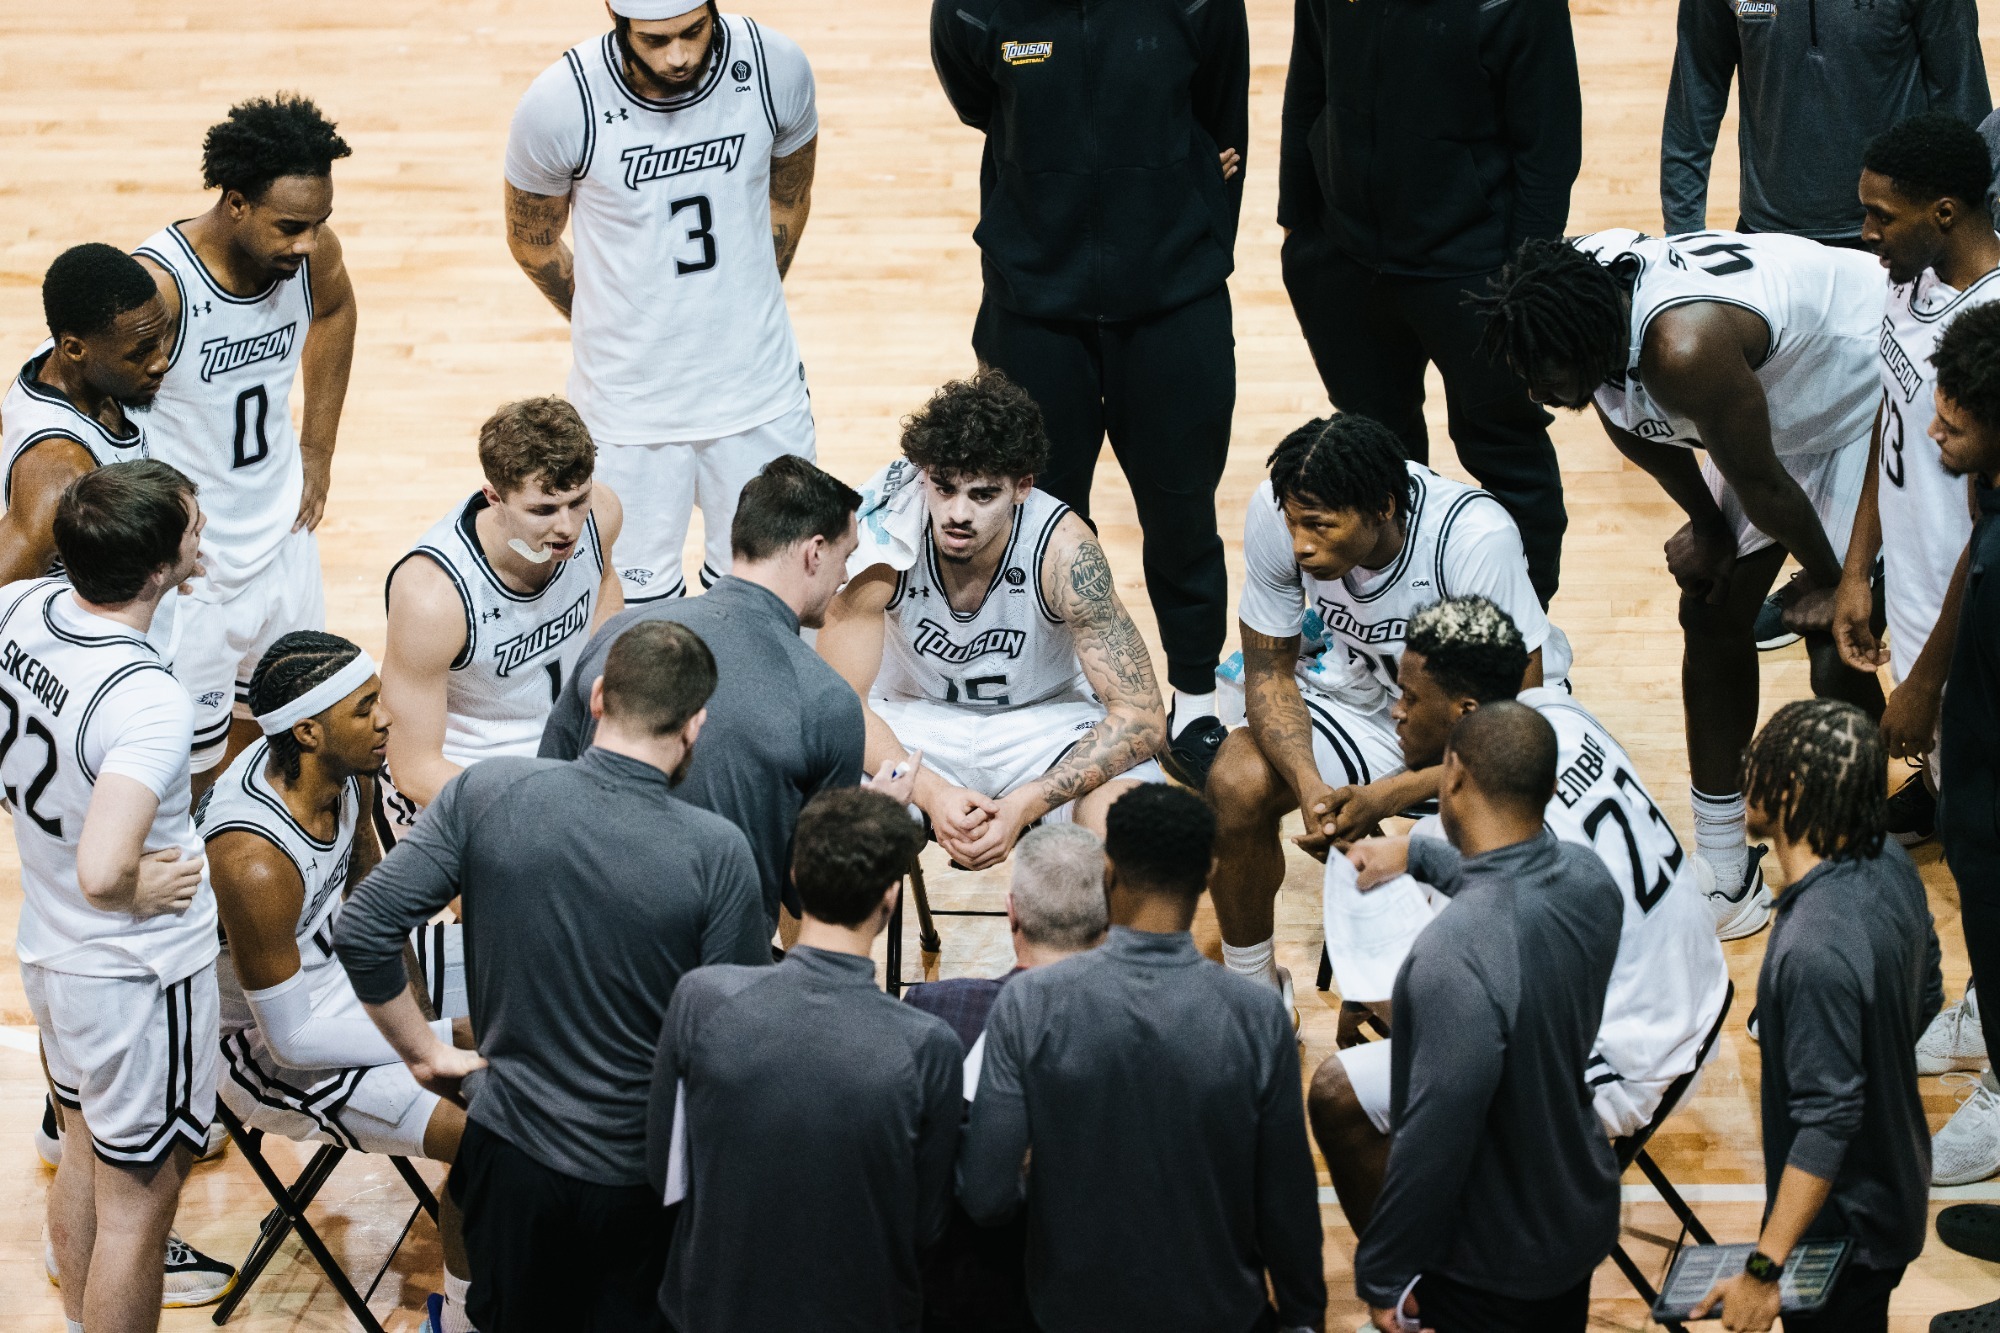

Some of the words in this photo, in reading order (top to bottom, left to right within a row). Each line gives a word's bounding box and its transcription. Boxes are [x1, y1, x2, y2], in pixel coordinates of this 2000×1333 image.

[1001, 41, 1053, 62] TOWSON
[621, 134, 745, 190] TOWSON
[671, 196, 716, 275] 3
[200, 321, 296, 382] TOWSON
[1879, 314, 1923, 404] TOWSON
[233, 384, 268, 468] 0
[494, 589, 590, 677] TOWSON
[914, 617, 1026, 664] TOWSON
[1318, 596, 1409, 644] TOWSO
[0, 639, 70, 718] SKERRY
[1583, 766, 1684, 915] 23
